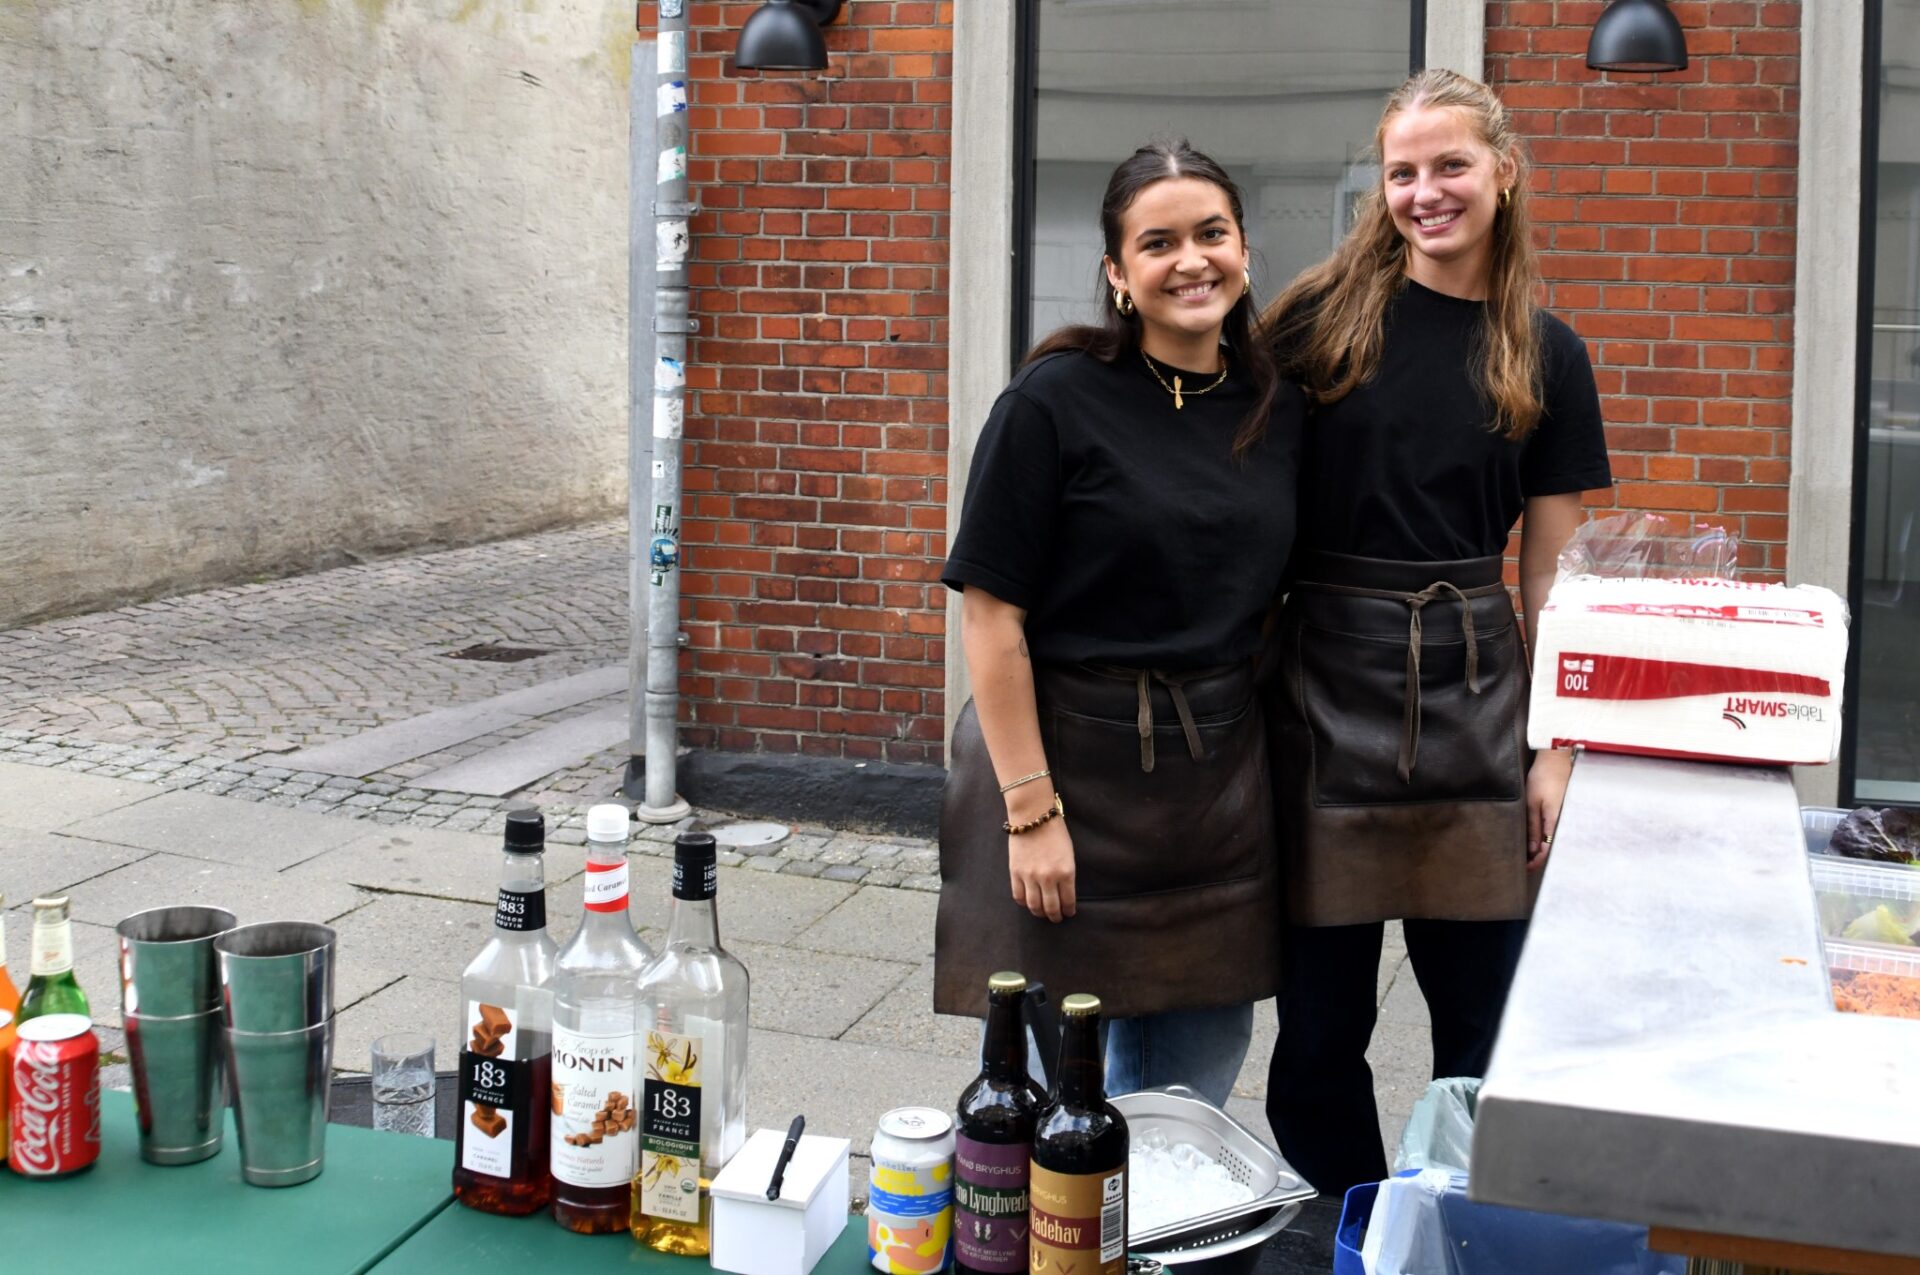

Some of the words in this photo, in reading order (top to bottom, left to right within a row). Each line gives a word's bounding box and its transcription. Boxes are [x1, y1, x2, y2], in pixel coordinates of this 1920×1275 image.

[1564, 673, 1590, 692] 100
[1722, 696, 1826, 722] TableSMART
[498, 899, 525, 915] 1883
[552, 1045, 624, 1072] MONIN
[472, 1092, 504, 1104] FRANCE
[653, 1124, 690, 1136] FRANCE
[648, 1137, 694, 1151] BIOLOGIQUE
[975, 1163, 1022, 1175] BRYGHUS
[1031, 1207, 1081, 1244] Vadehav
